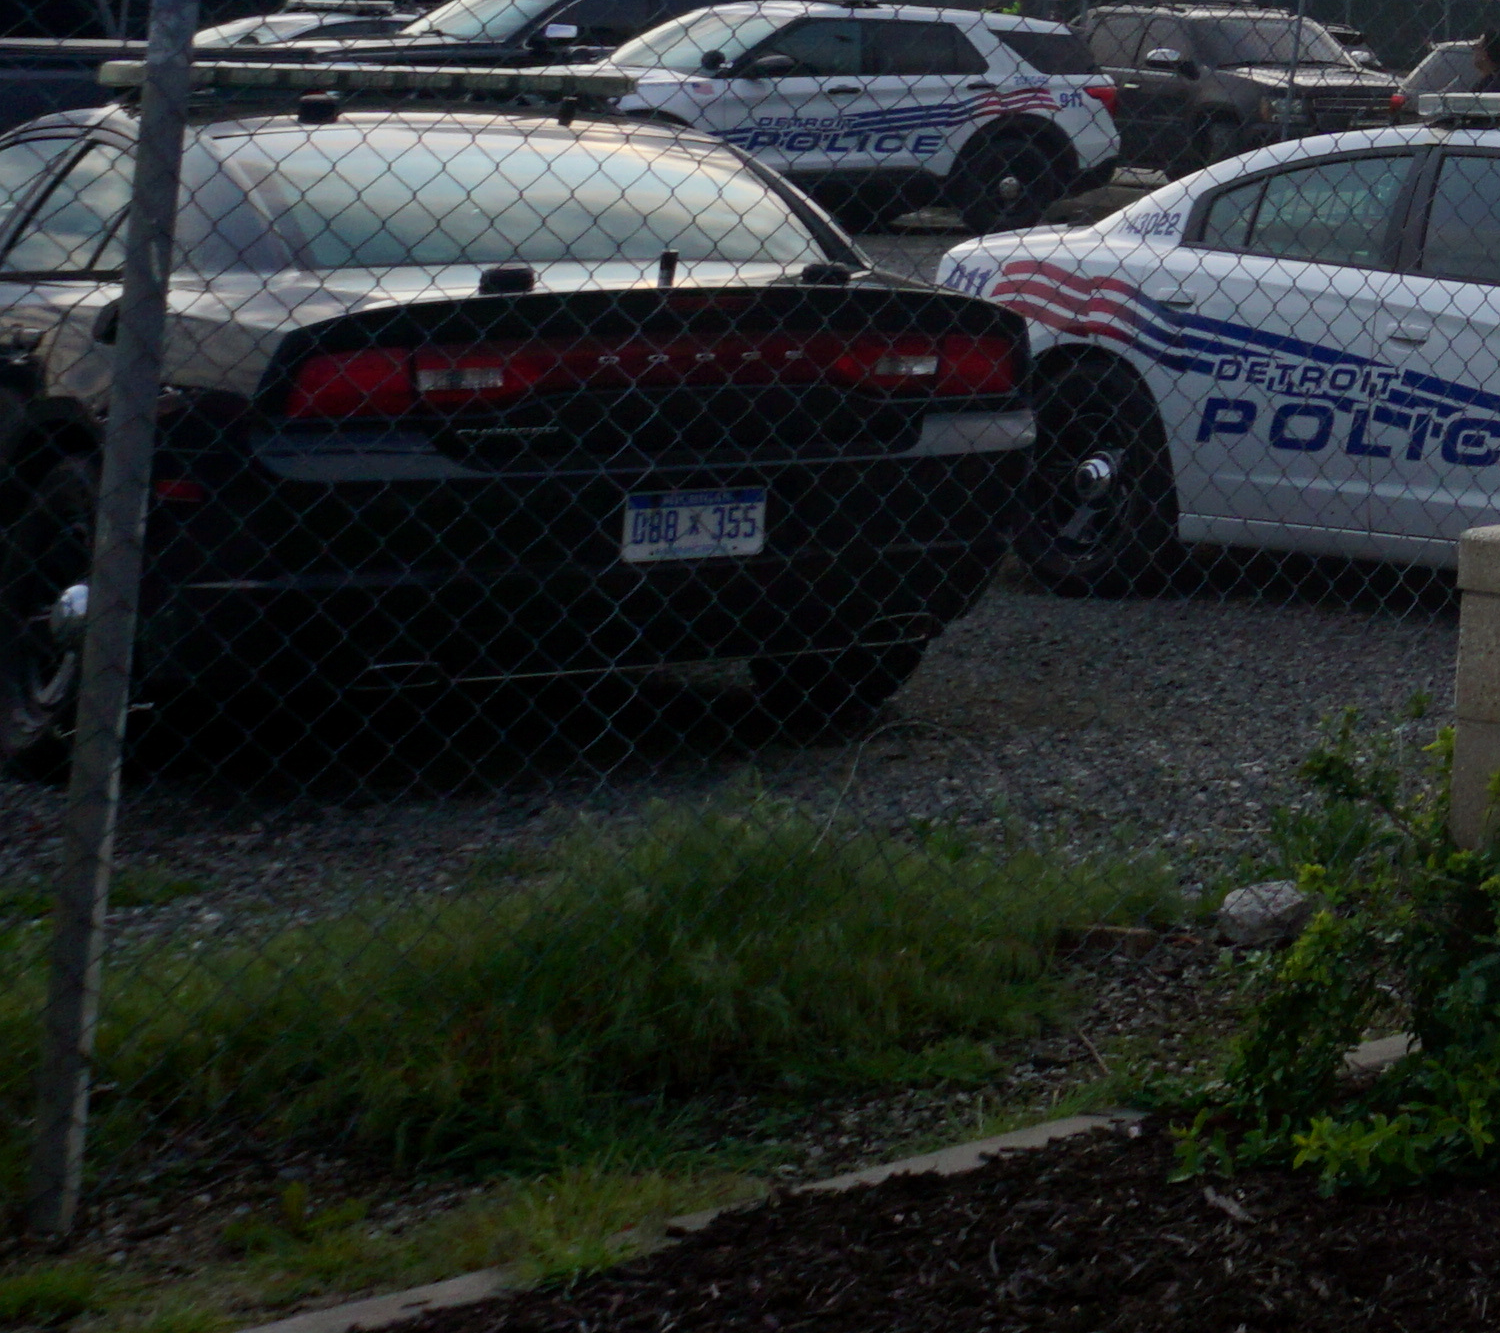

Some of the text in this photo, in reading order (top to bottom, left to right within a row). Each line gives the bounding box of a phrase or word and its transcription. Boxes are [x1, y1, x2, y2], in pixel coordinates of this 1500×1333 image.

[1060, 92, 1082, 108] 911
[758, 116, 852, 129] DETROIT
[747, 130, 942, 154] POLICE
[1215, 357, 1400, 397] DETROIT
